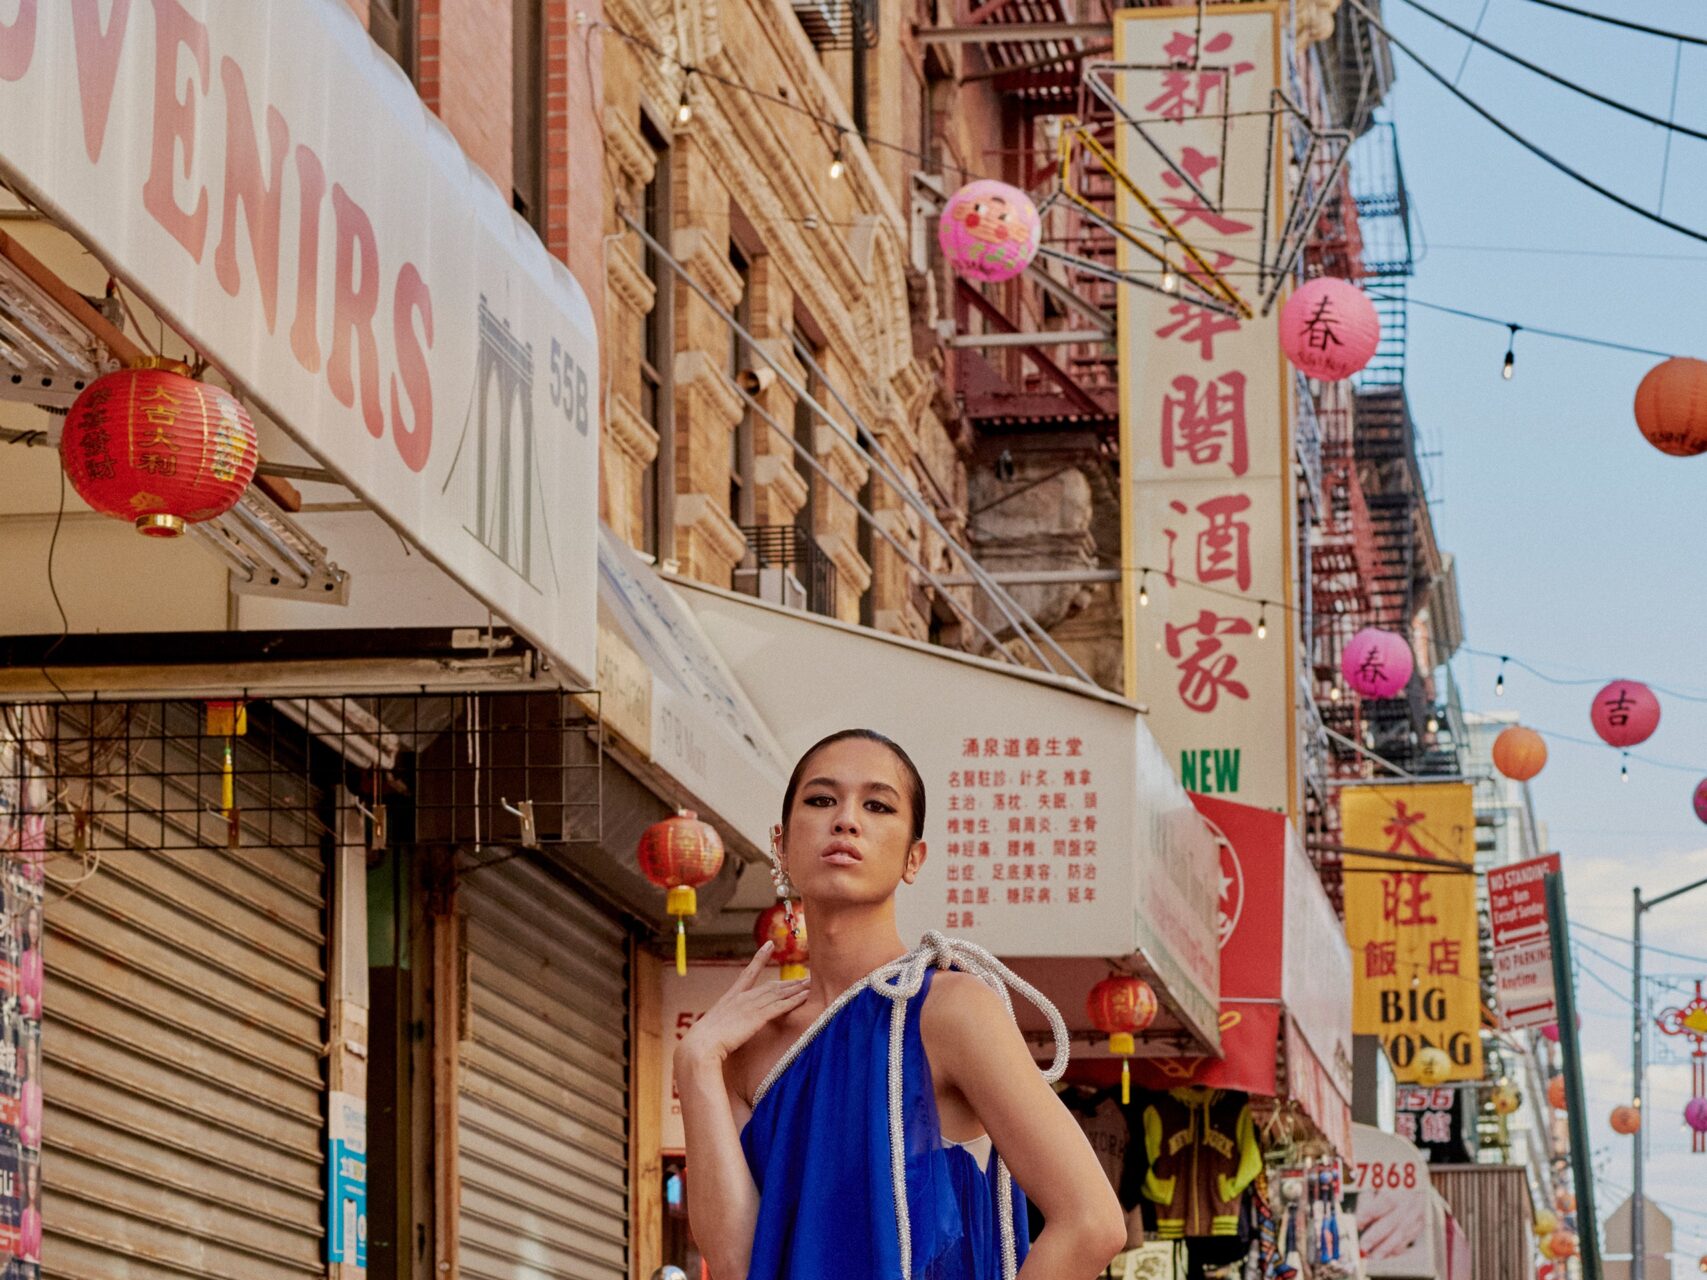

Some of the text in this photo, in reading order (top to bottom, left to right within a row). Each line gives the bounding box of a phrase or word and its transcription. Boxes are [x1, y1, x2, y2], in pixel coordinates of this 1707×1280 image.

[0, 0, 434, 473] VENIRS
[1300, 295, 1345, 351] 春
[549, 336, 588, 437] 55B
[139, 385, 182, 477] 大吉大利
[1605, 690, 1636, 726] 吉
[1181, 749, 1240, 793] NEW
[1383, 800, 1438, 925] 大旺
[1490, 874, 1504, 891] NO
[1364, 937, 1461, 979] 飯店
[1381, 988, 1446, 1023] BIG
[1382, 1032, 1472, 1068] OG
[1356, 1162, 1416, 1189] 7868
